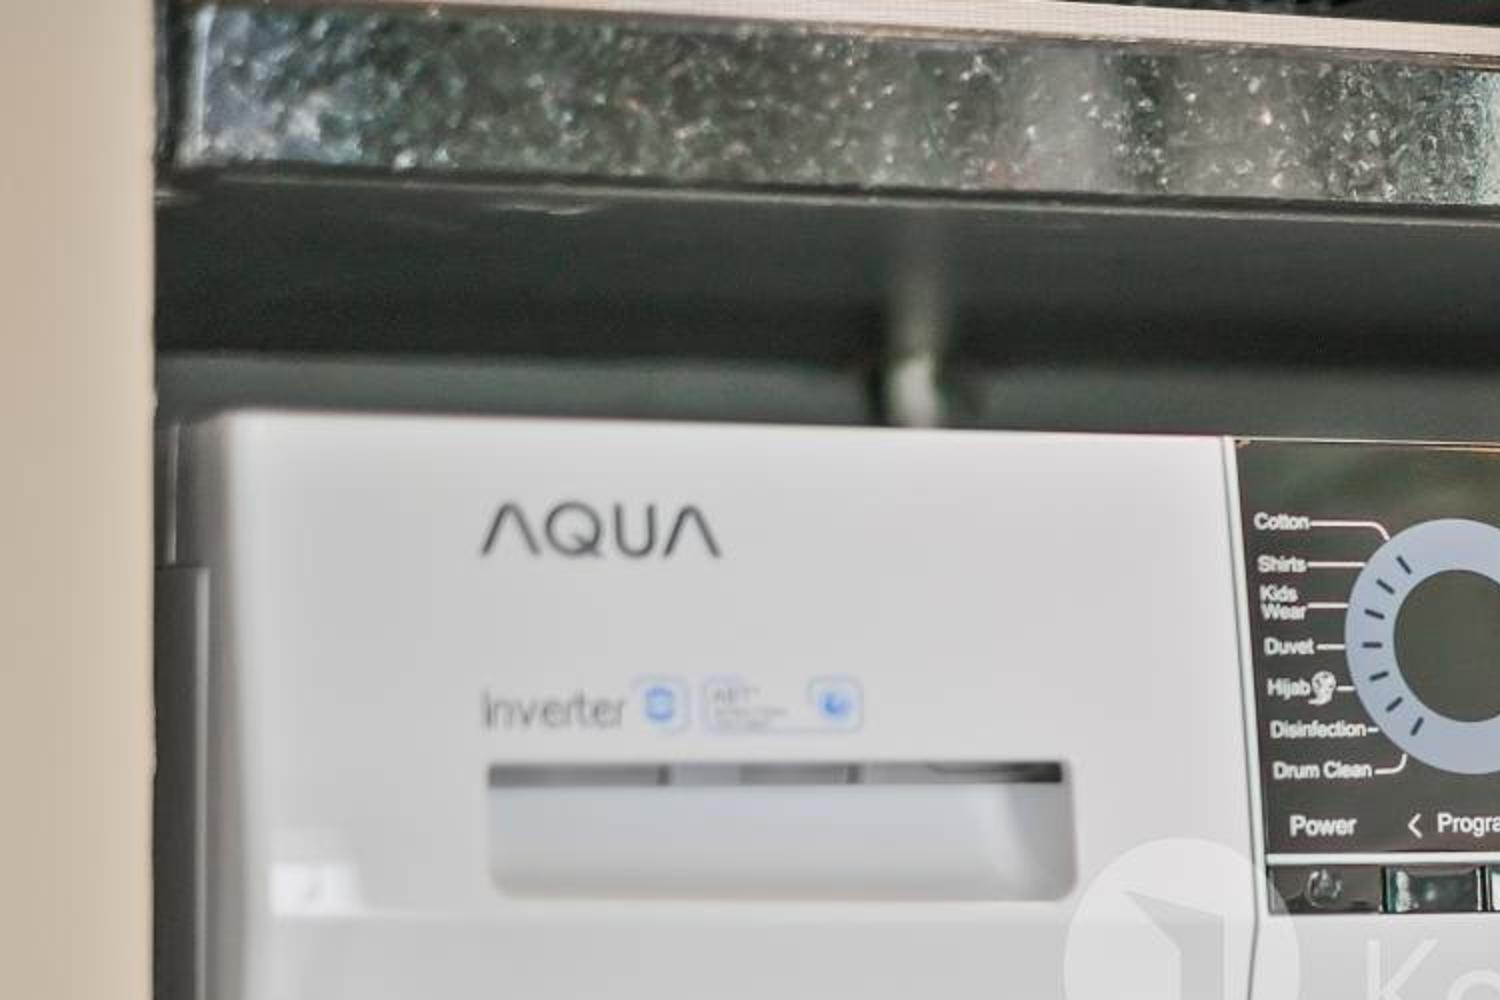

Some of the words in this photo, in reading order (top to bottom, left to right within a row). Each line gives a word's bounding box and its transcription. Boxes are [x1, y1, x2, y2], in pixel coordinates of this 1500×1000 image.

[481, 500, 722, 558] AQUA
[1254, 512, 1310, 531] Cotton
[1257, 555, 1307, 573] Shirts
[1260, 584, 1298, 602] Kids
[1261, 603, 1307, 620] Wear
[1264, 638, 1315, 655] Duvet
[1267, 678, 1311, 698] Hijab
[481, 687, 625, 731] Inverter
[1270, 720, 1367, 738] Disinfection
[1273, 761, 1320, 779] Drum
[1323, 761, 1373, 779] Clean
[1289, 814, 1357, 835] Power
